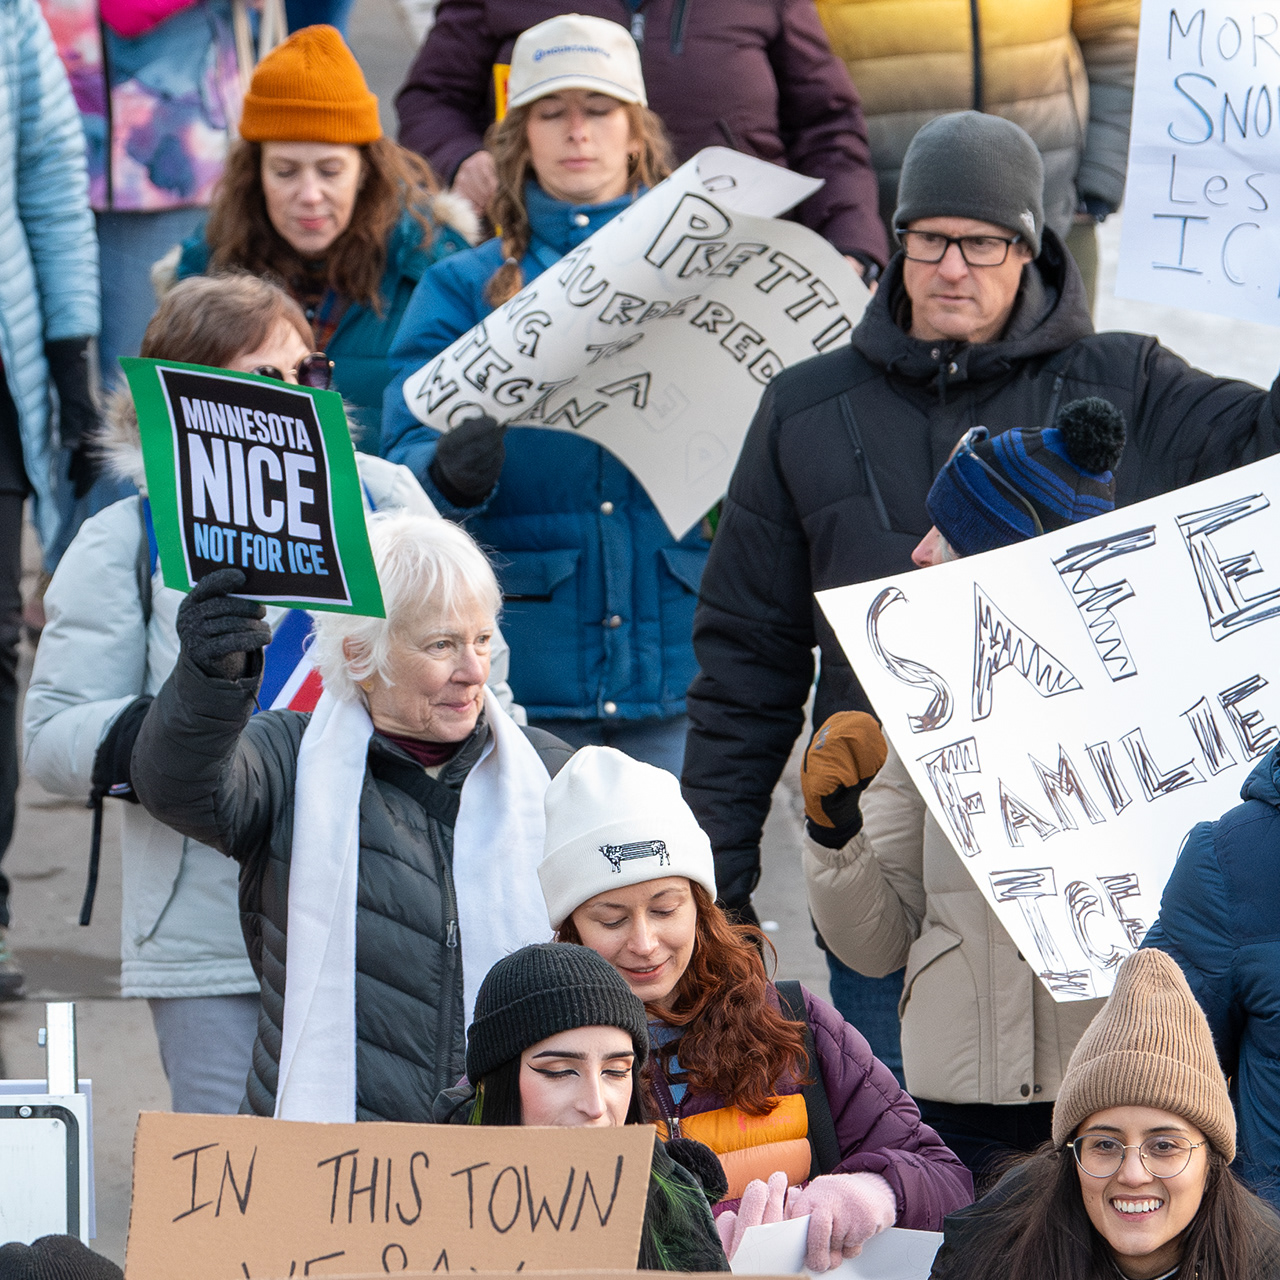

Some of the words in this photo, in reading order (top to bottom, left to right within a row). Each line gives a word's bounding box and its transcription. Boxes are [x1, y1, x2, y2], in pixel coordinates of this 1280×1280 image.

[644, 191, 852, 352] PRETTI
[179, 396, 313, 452] MINNESOTA
[187, 432, 322, 540] NICE
[193, 522, 237, 565] NOT
[241, 532, 285, 573] FOR
[287, 541, 329, 576] ICE
[172, 1143, 258, 1223] IN
[318, 1148, 430, 1226] THIS
[451, 1154, 624, 1234] TOWN
